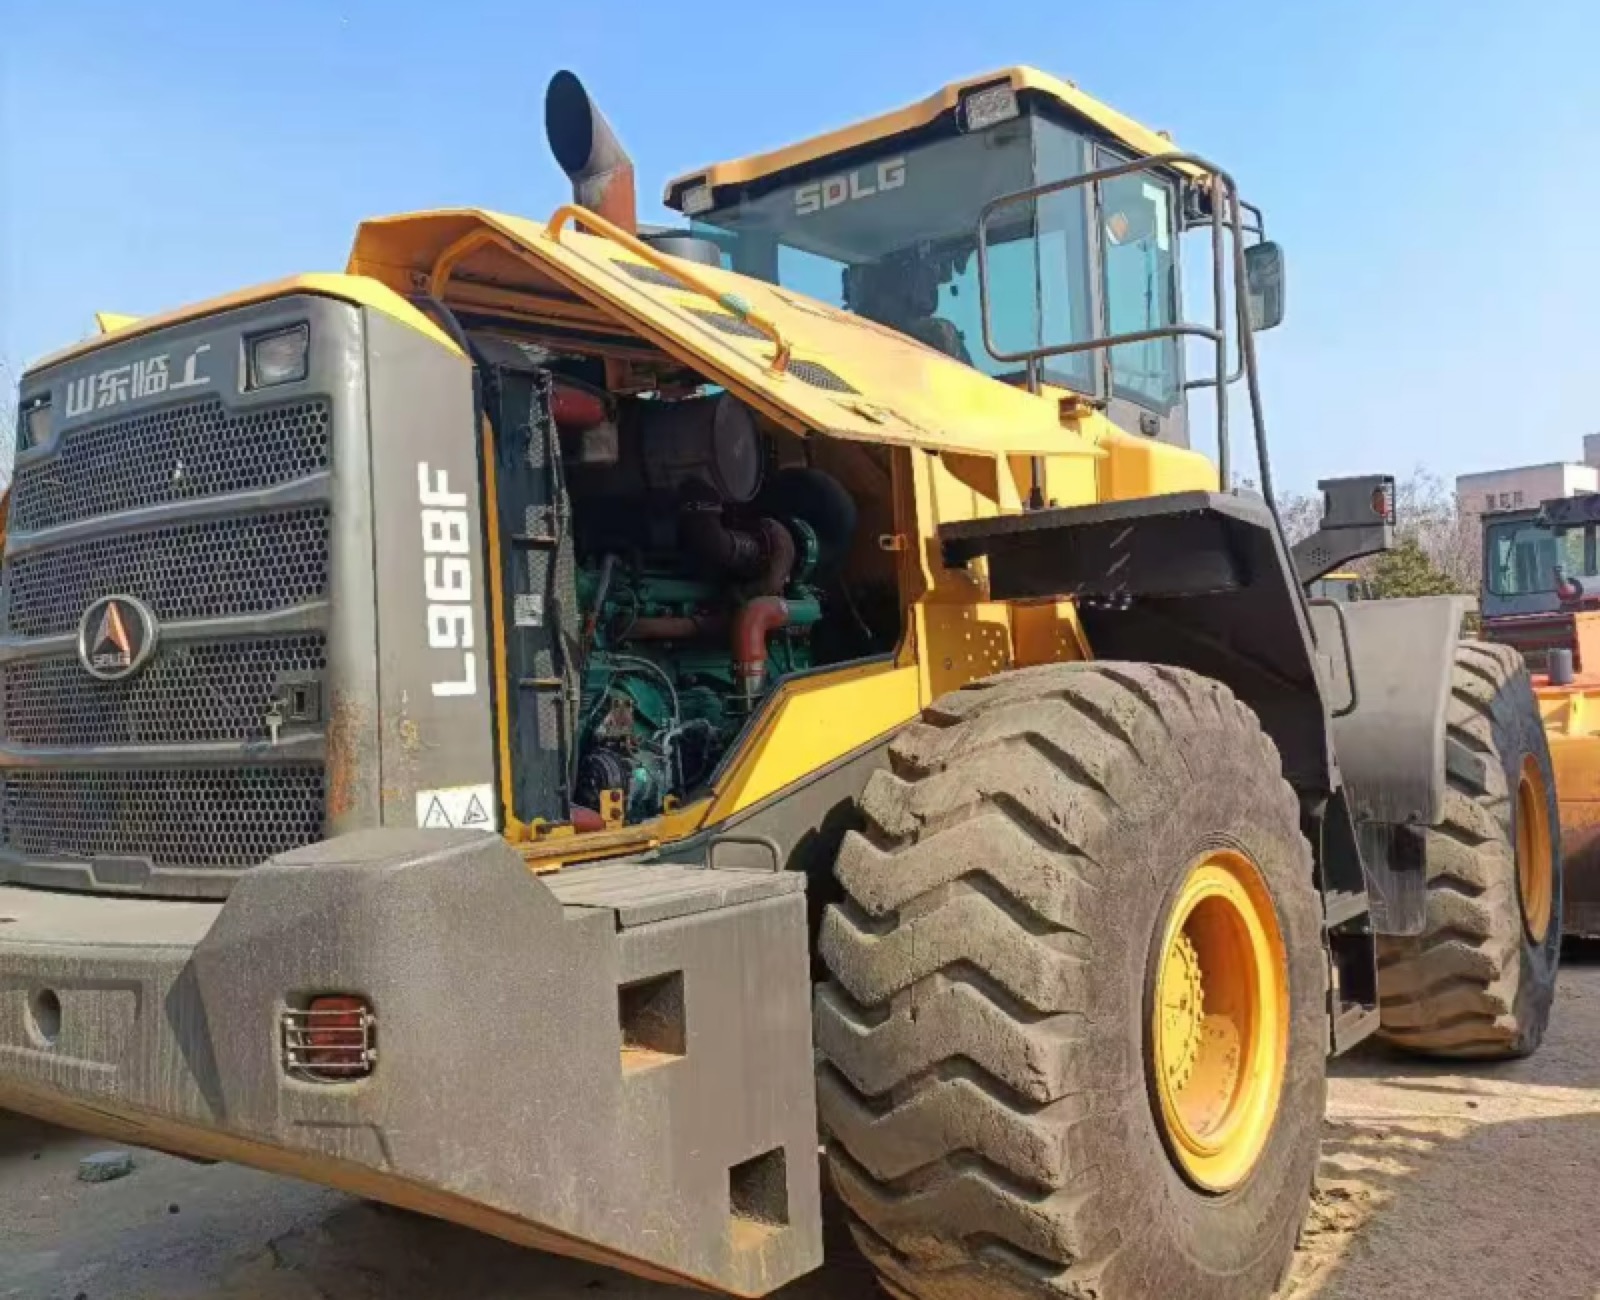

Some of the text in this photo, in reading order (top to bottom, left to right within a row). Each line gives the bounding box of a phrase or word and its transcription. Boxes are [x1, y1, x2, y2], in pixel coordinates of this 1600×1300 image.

[796, 157, 906, 215] SDLG
[65, 344, 211, 418] 山东临工
[417, 461, 476, 697] L968F
